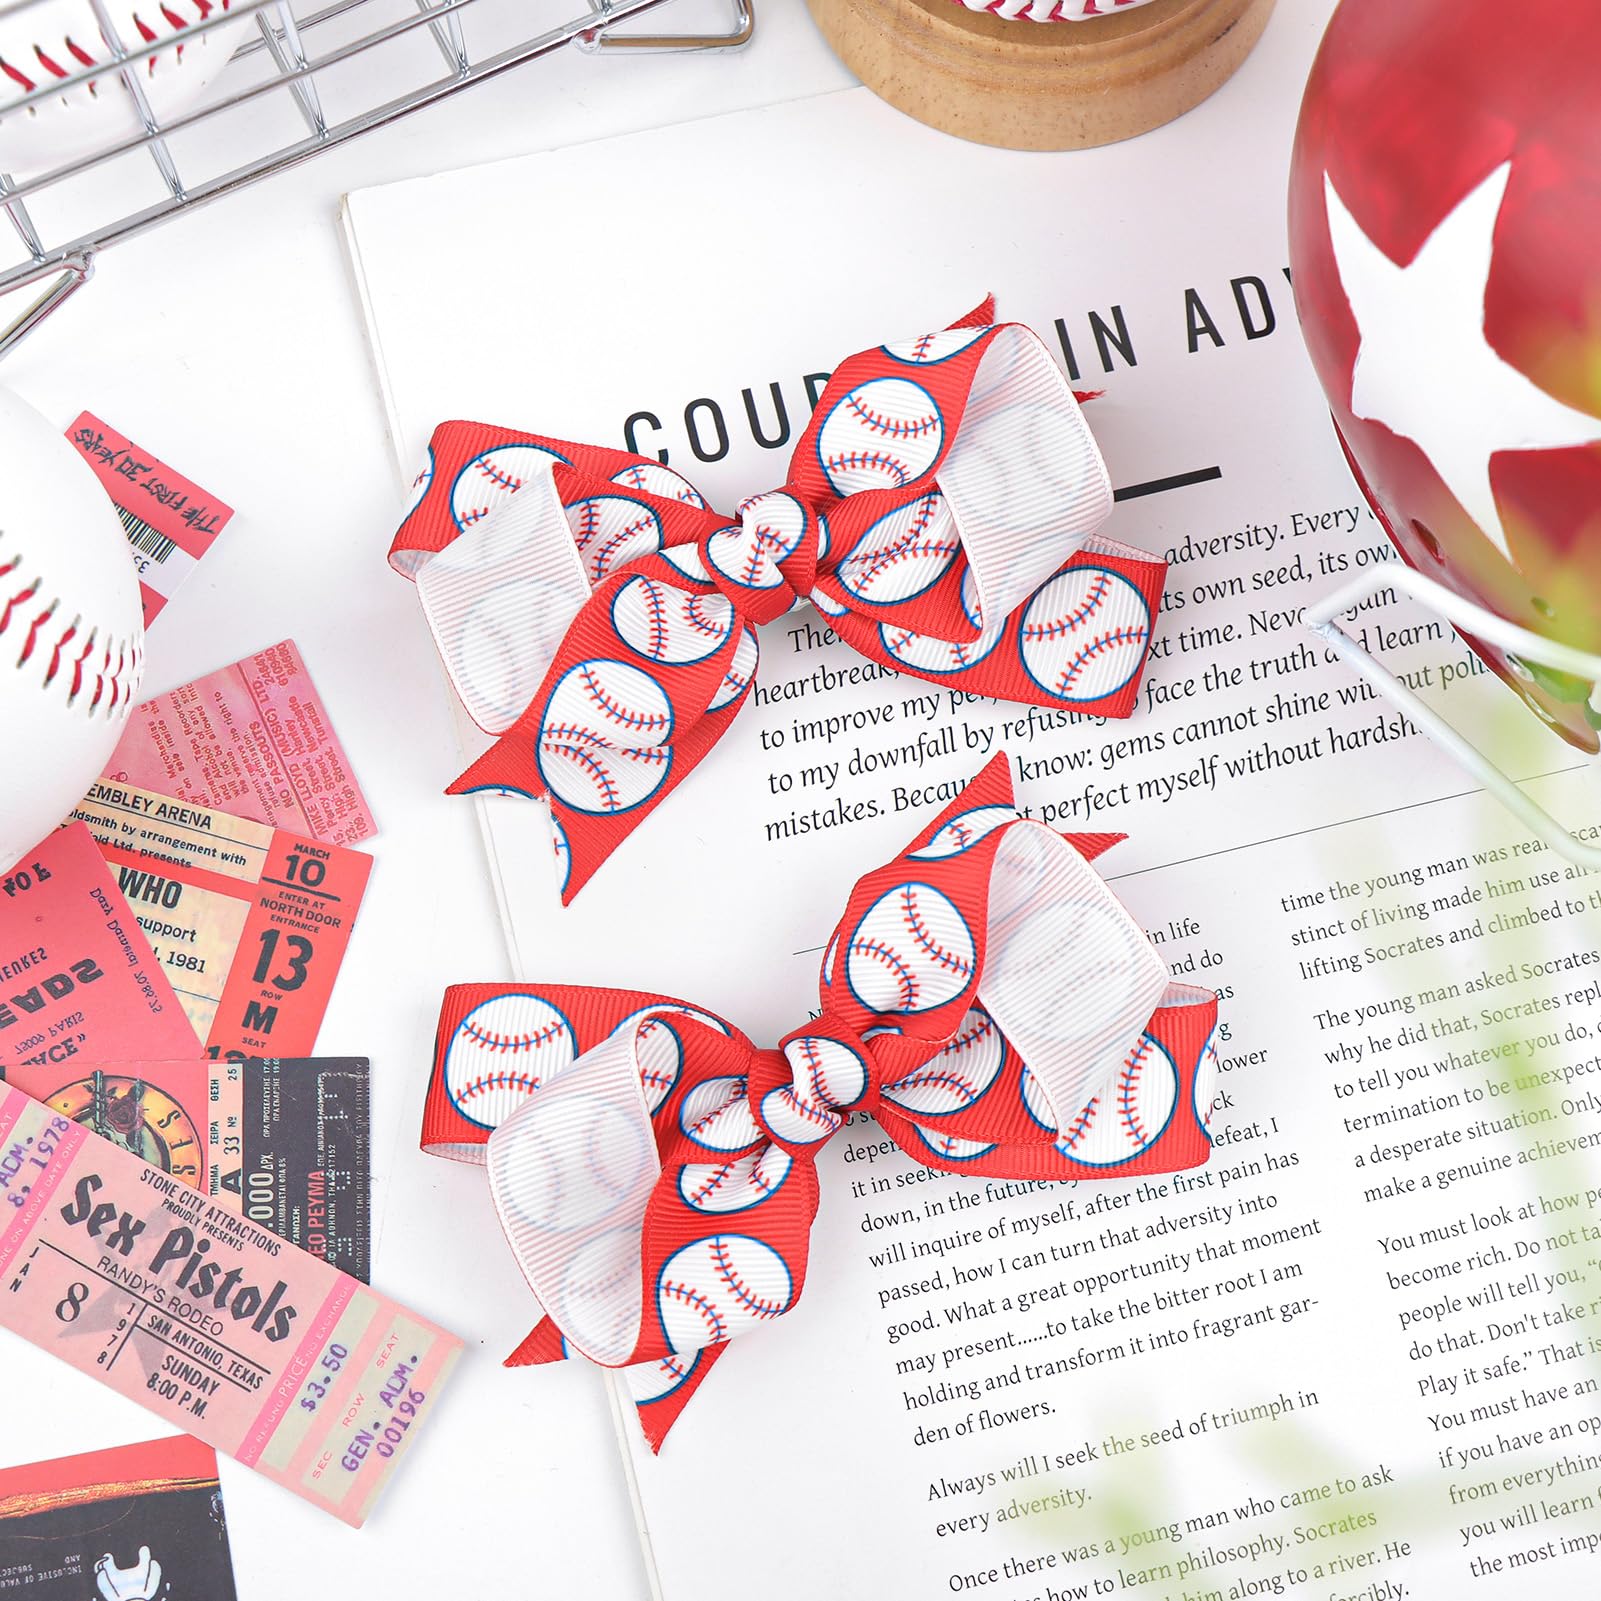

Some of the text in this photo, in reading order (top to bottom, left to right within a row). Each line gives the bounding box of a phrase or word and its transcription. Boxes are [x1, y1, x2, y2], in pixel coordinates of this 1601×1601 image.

[1053, 304, 1138, 381] IN
[74, 427, 122, 465] YEARS
[139, 477, 192, 511] FIRST
[179, 506, 221, 535] THE
[1163, 506, 1359, 566] adversity. Every
[753, 552, 1348, 707] heartbreak, own seed, its
[760, 624, 1242, 750] to improve my time.
[768, 622, 1443, 794] to my downfall by face the truth learn
[249, 720, 295, 809] NO PASSOUTS
[252, 676, 329, 836] MIKE LLOYD (MUSIC) LTD.
[764, 798, 885, 841] mistakes.
[1016, 749, 1092, 782] know:
[1101, 732, 1165, 770] gems
[1173, 706, 1259, 745] cannot
[1266, 693, 1331, 723] shine
[1040, 712, 1423, 824] perfect myself without hardsh
[87, 783, 213, 830] EMBLEY ARENA
[113, 838, 136, 854] Ltd.
[140, 848, 192, 869] presents
[121, 822, 137, 835] by
[140, 829, 217, 858] arrangement
[220, 851, 247, 866] with
[285, 854, 326, 887] 10
[293, 843, 331, 860] MARCH
[118, 866, 183, 909] WHO
[259, 897, 341, 929] NORTH DOOR
[278, 891, 326, 910] ENTER AT
[135, 916, 197, 943] support
[270, 913, 320, 934] ENTRANCE
[1299, 900, 1563, 980] lifting Socrates and climbed
[166, 951, 206, 974] 1981
[252, 928, 314, 991] 13
[241, 999, 279, 1035] M
[260, 989, 283, 1001] ROW
[1313, 951, 1600, 1030] The young man asked Socrates
[241, 1036, 267, 1049] SEAT
[140, 1168, 282, 1257] STONE CITY ATTRACTIONS
[161, 1199, 245, 1252] PROUDLY PRESENTS
[869, 1171, 1214, 1267] will inquire of myself, after the first
[1377, 1194, 1579, 1254] You must look at how
[60, 1174, 298, 1343] Sex Pistols
[878, 1195, 1277, 1309] passed, how I can turn that adversity into
[55, 1282, 90, 1322] 8
[97, 1256, 225, 1336] RANDY'S RODEO
[147, 1315, 264, 1390] SAN ANTONIO, TEXAS
[903, 1299, 1318, 1410] holding and transform it into fragrant gar-
[1409, 1303, 1585, 1360] do that. Don't take
[147, 1372, 208, 1419] 8:00 P.M.
[162, 1355, 220, 1396] SUNDAY
[300, 1343, 347, 1412] $3.50
[312, 1333, 399, 1479] SEC ROW SEAT
[341, 1355, 418, 1472] GEN. ADM.
[376, 1387, 426, 1458] 00196
[914, 1402, 1055, 1446] den of flowers.
[928, 1394, 1294, 1501] Always will seek the seed of triumph
